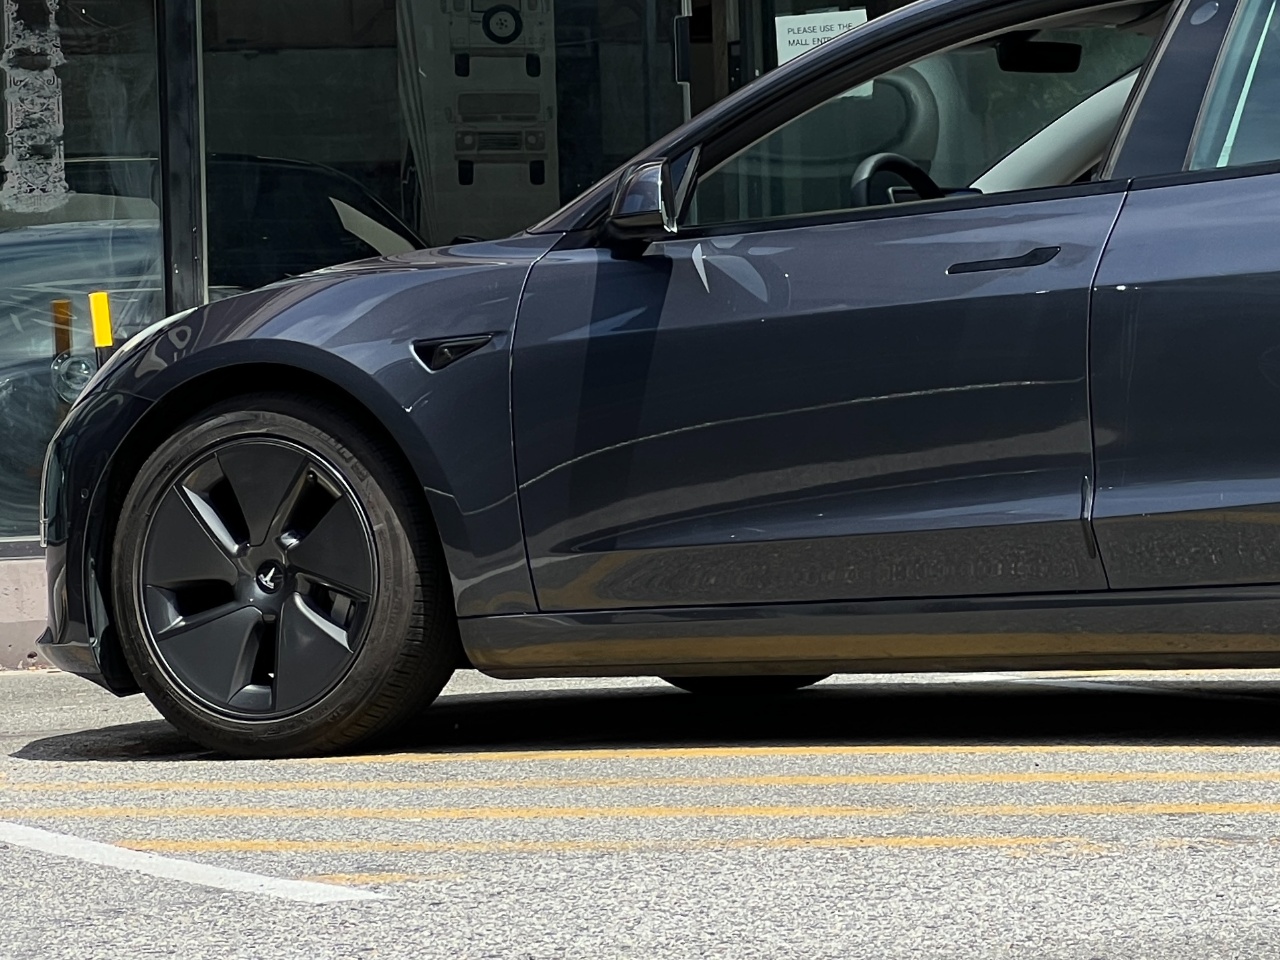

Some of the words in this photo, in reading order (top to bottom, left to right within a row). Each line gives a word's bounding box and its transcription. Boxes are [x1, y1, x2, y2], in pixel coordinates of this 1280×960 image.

[787, 26, 817, 34] PLEASE
[819, 24, 834, 32] USE
[788, 38, 810, 46] MALL
